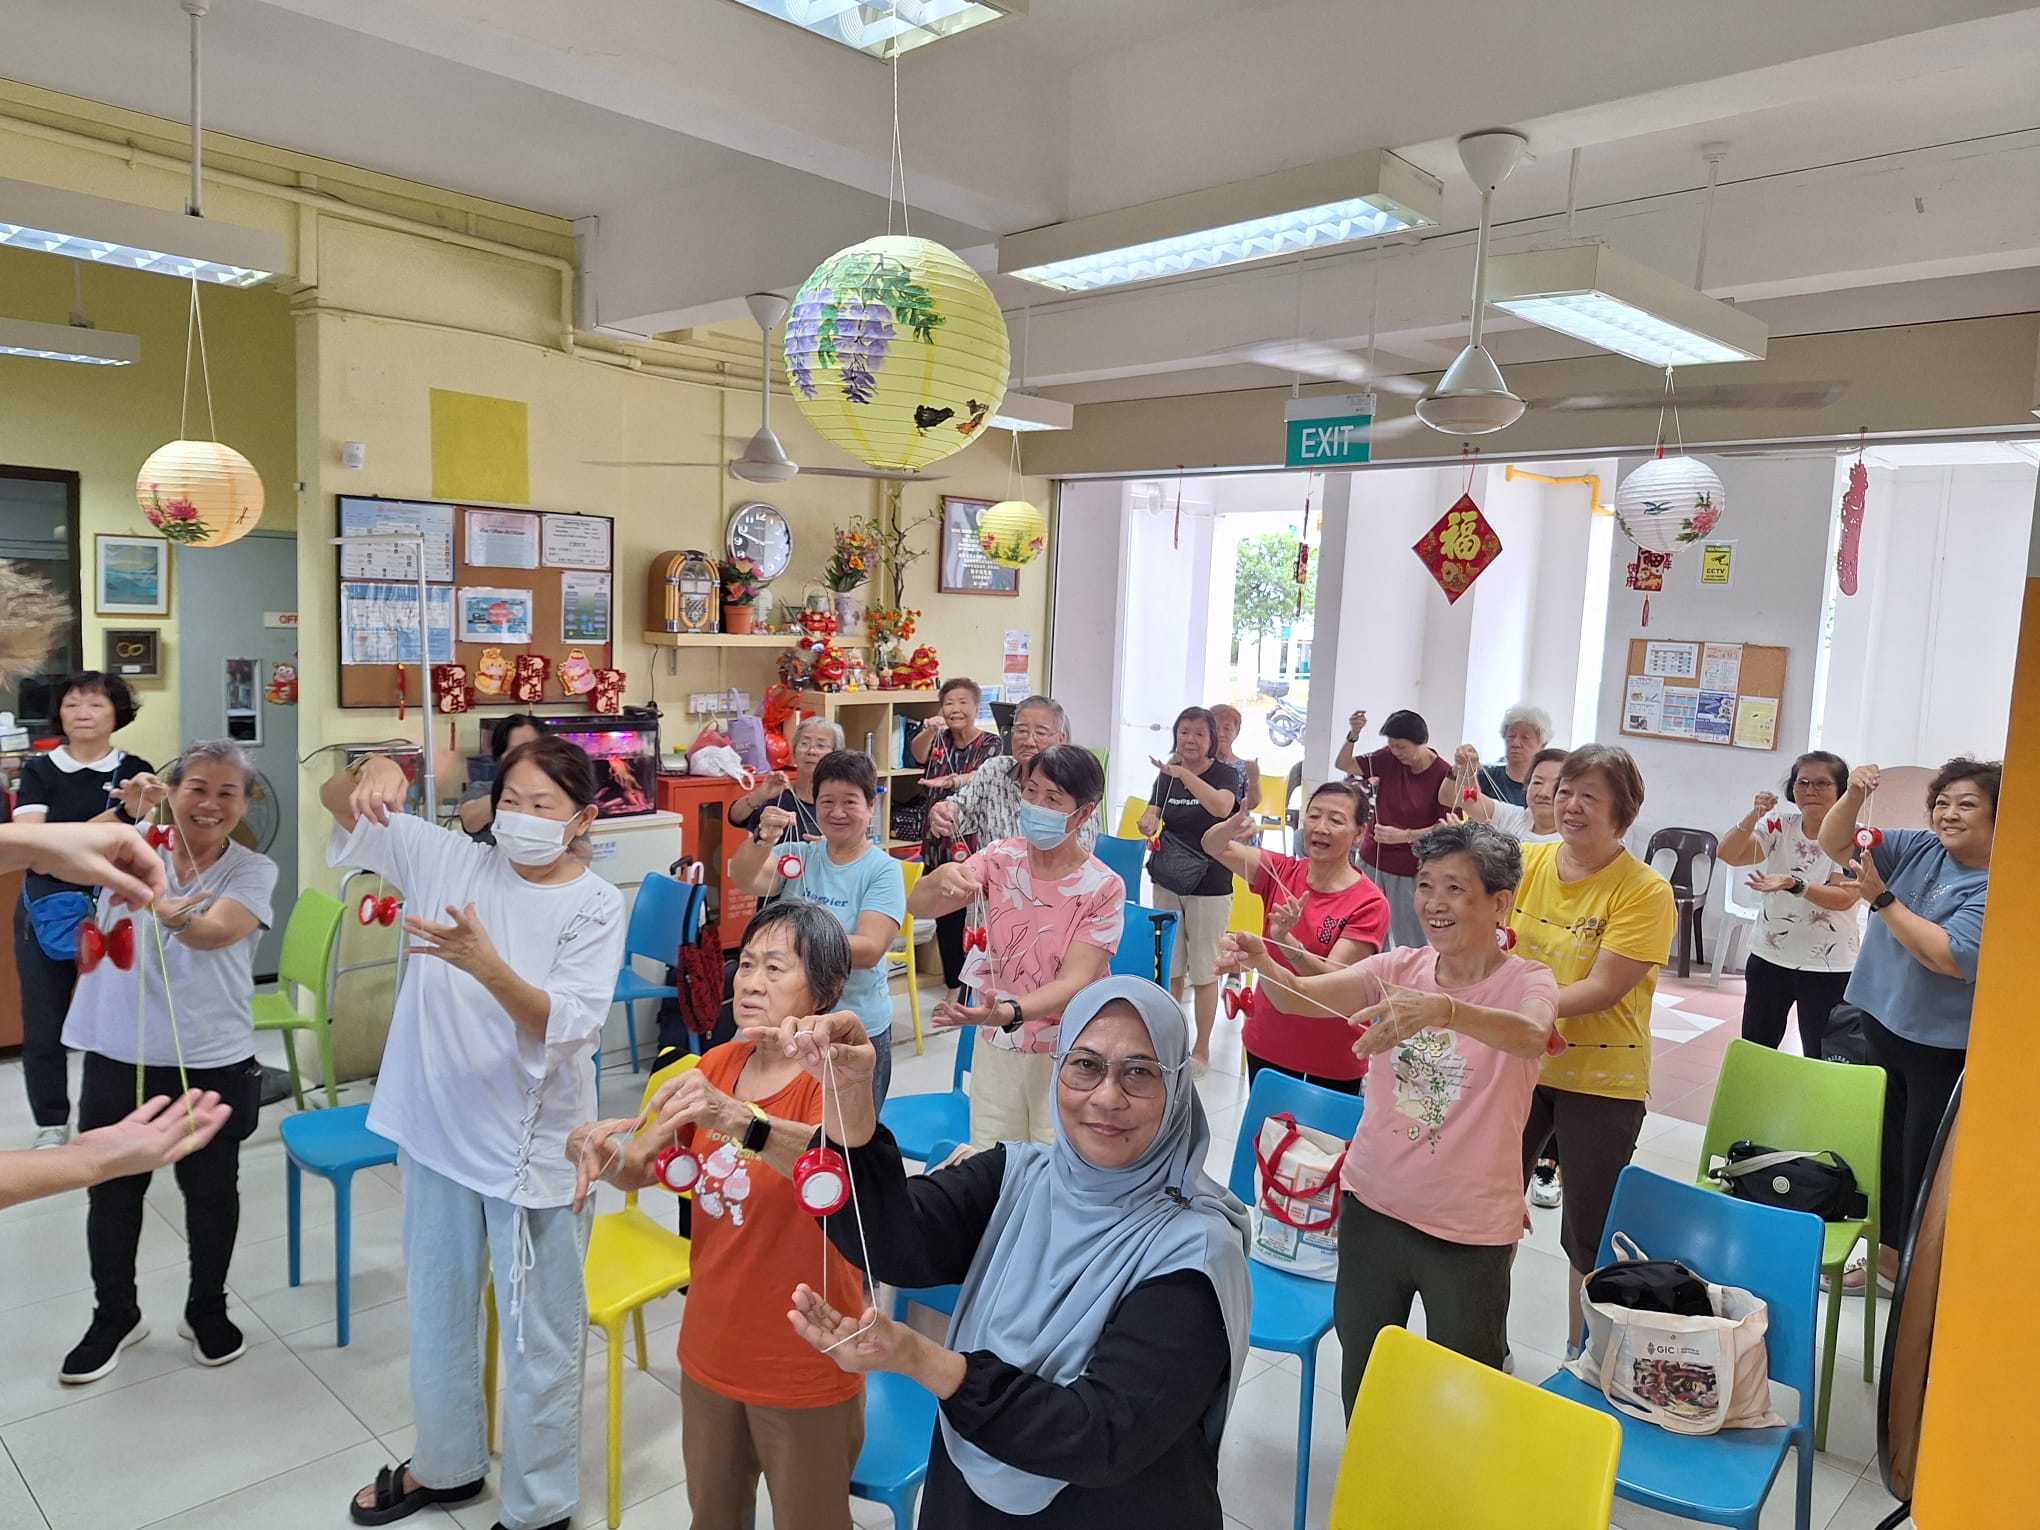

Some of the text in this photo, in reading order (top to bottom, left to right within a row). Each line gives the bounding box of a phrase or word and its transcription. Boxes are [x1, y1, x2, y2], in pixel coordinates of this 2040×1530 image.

[1301, 425, 1354, 458] EXIT
[756, 511, 766, 521] 12
[1439, 510, 1481, 561] 福
[1706, 567, 1726, 575] CCTV
[1656, 1345, 1675, 1354] GIC
